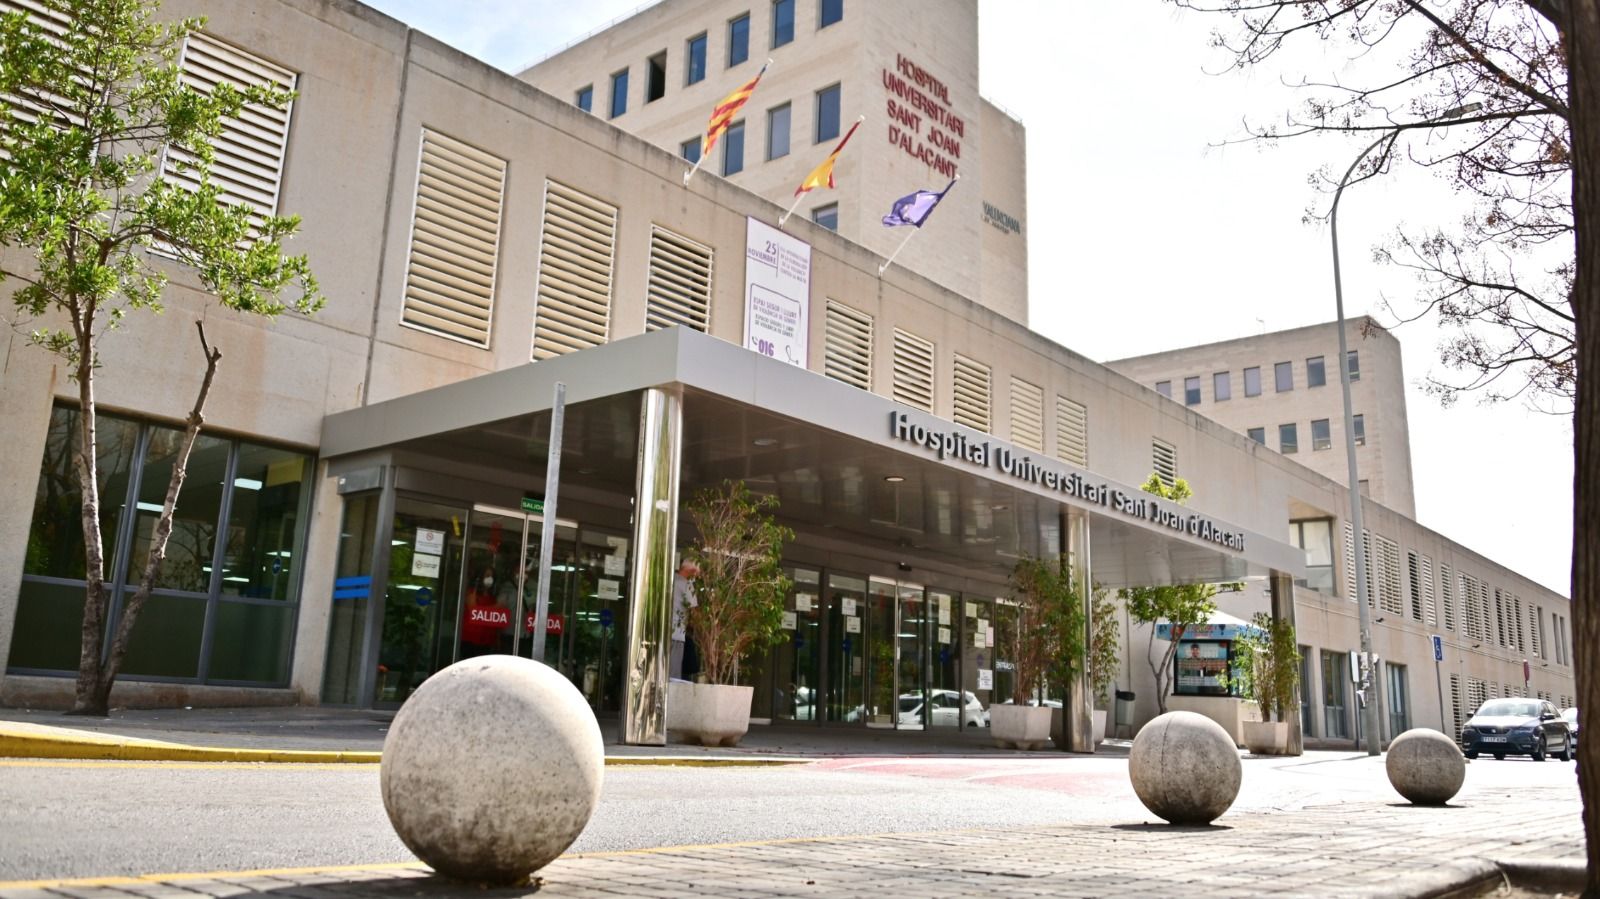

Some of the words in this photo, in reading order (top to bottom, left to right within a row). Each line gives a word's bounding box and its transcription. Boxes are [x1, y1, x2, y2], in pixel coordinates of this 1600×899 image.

[882, 68, 964, 138] UNIVERSITARI
[897, 53, 952, 107] HOSPITAL
[887, 99, 922, 134] SANT
[928, 126, 960, 159] JOAN
[888, 124, 958, 180] D'ALACANT
[766, 240, 777, 255] 25
[758, 339, 775, 357] 016
[890, 411, 992, 467] Hospital
[996, 446, 1110, 507] Universitari
[1111, 488, 1147, 519] Sant
[1150, 501, 1187, 531] Joan
[1188, 514, 1246, 552] d'Alacant
[471, 609, 507, 623] SALIDA
